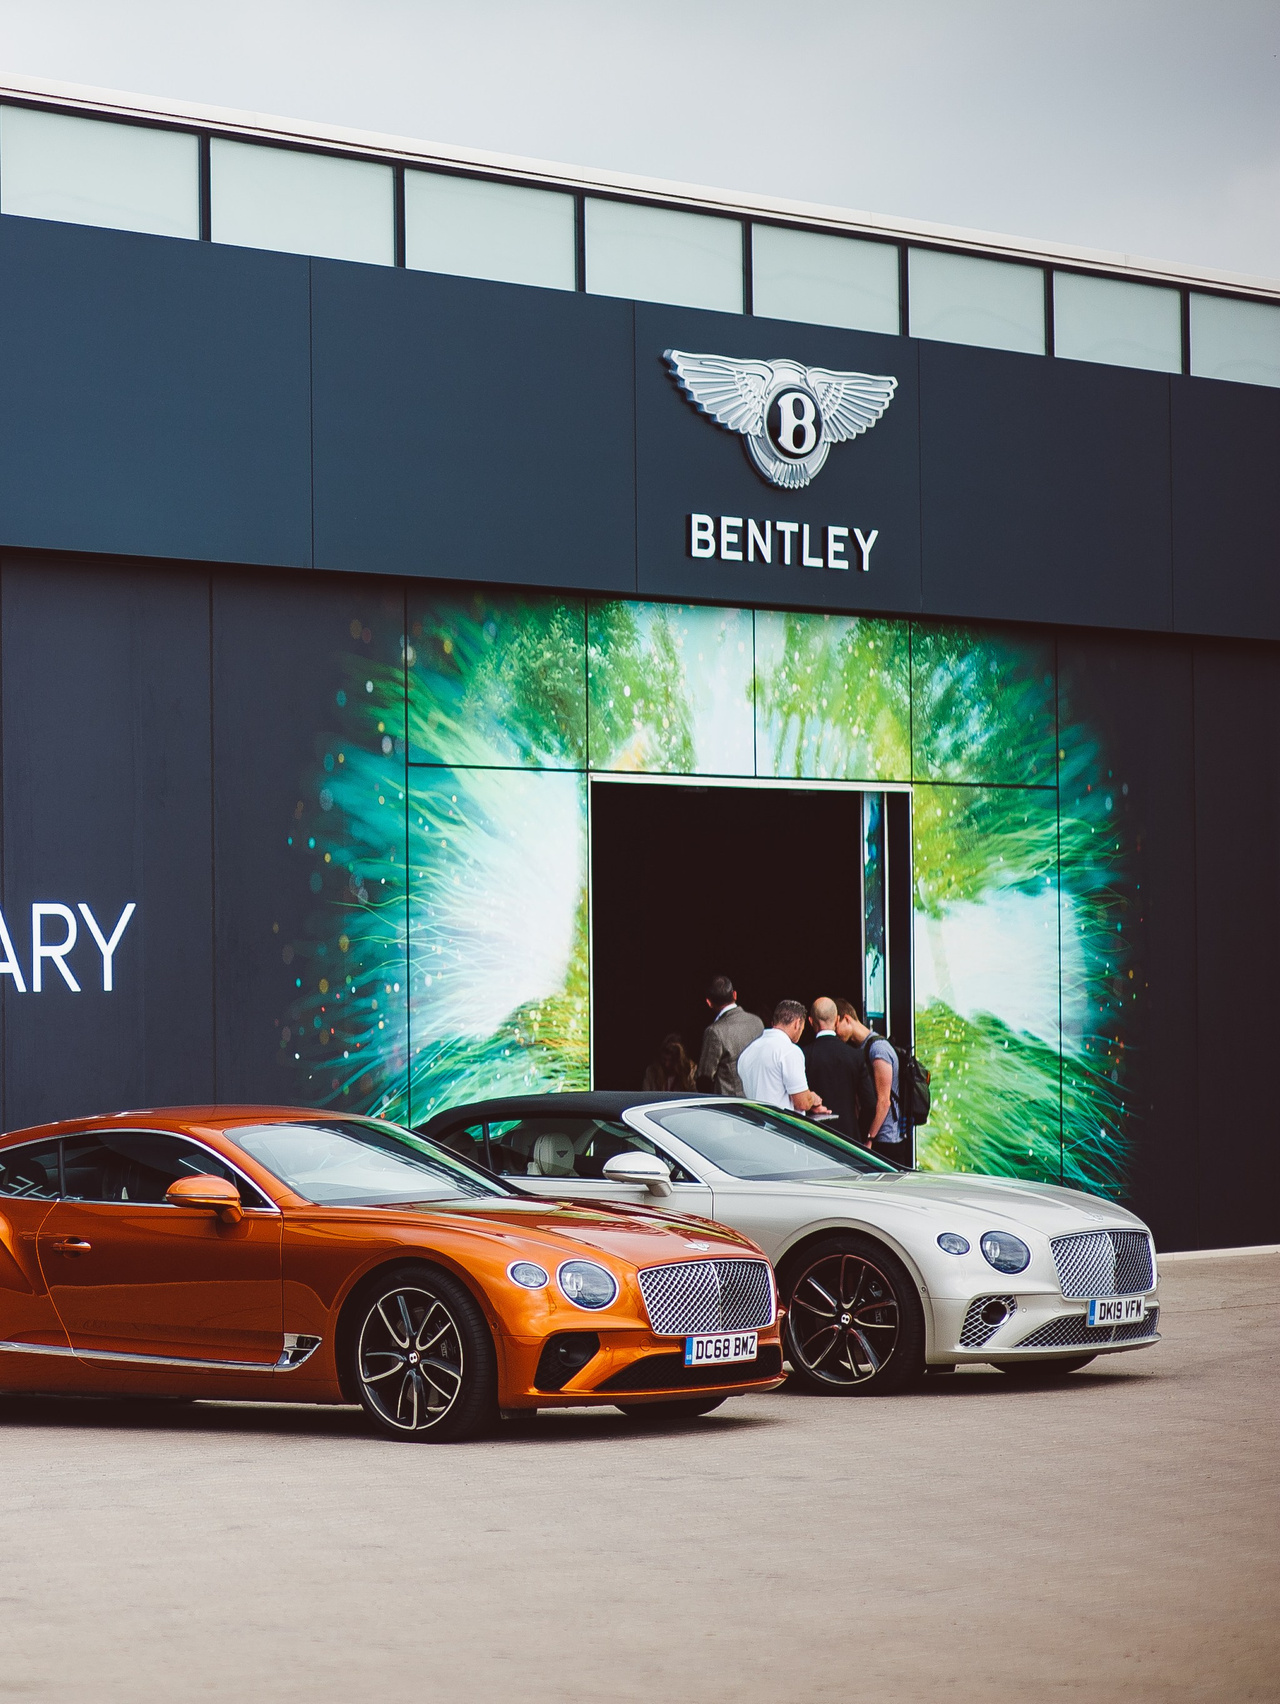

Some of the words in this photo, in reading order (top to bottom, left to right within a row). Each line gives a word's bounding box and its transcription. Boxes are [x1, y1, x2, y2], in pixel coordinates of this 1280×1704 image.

[777, 391, 817, 455] B
[690, 513, 879, 572] BENTLEY
[1099, 1301, 1122, 1320] DK19
[695, 1339, 730, 1360] DC68
[734, 1335, 756, 1357] BMZ
